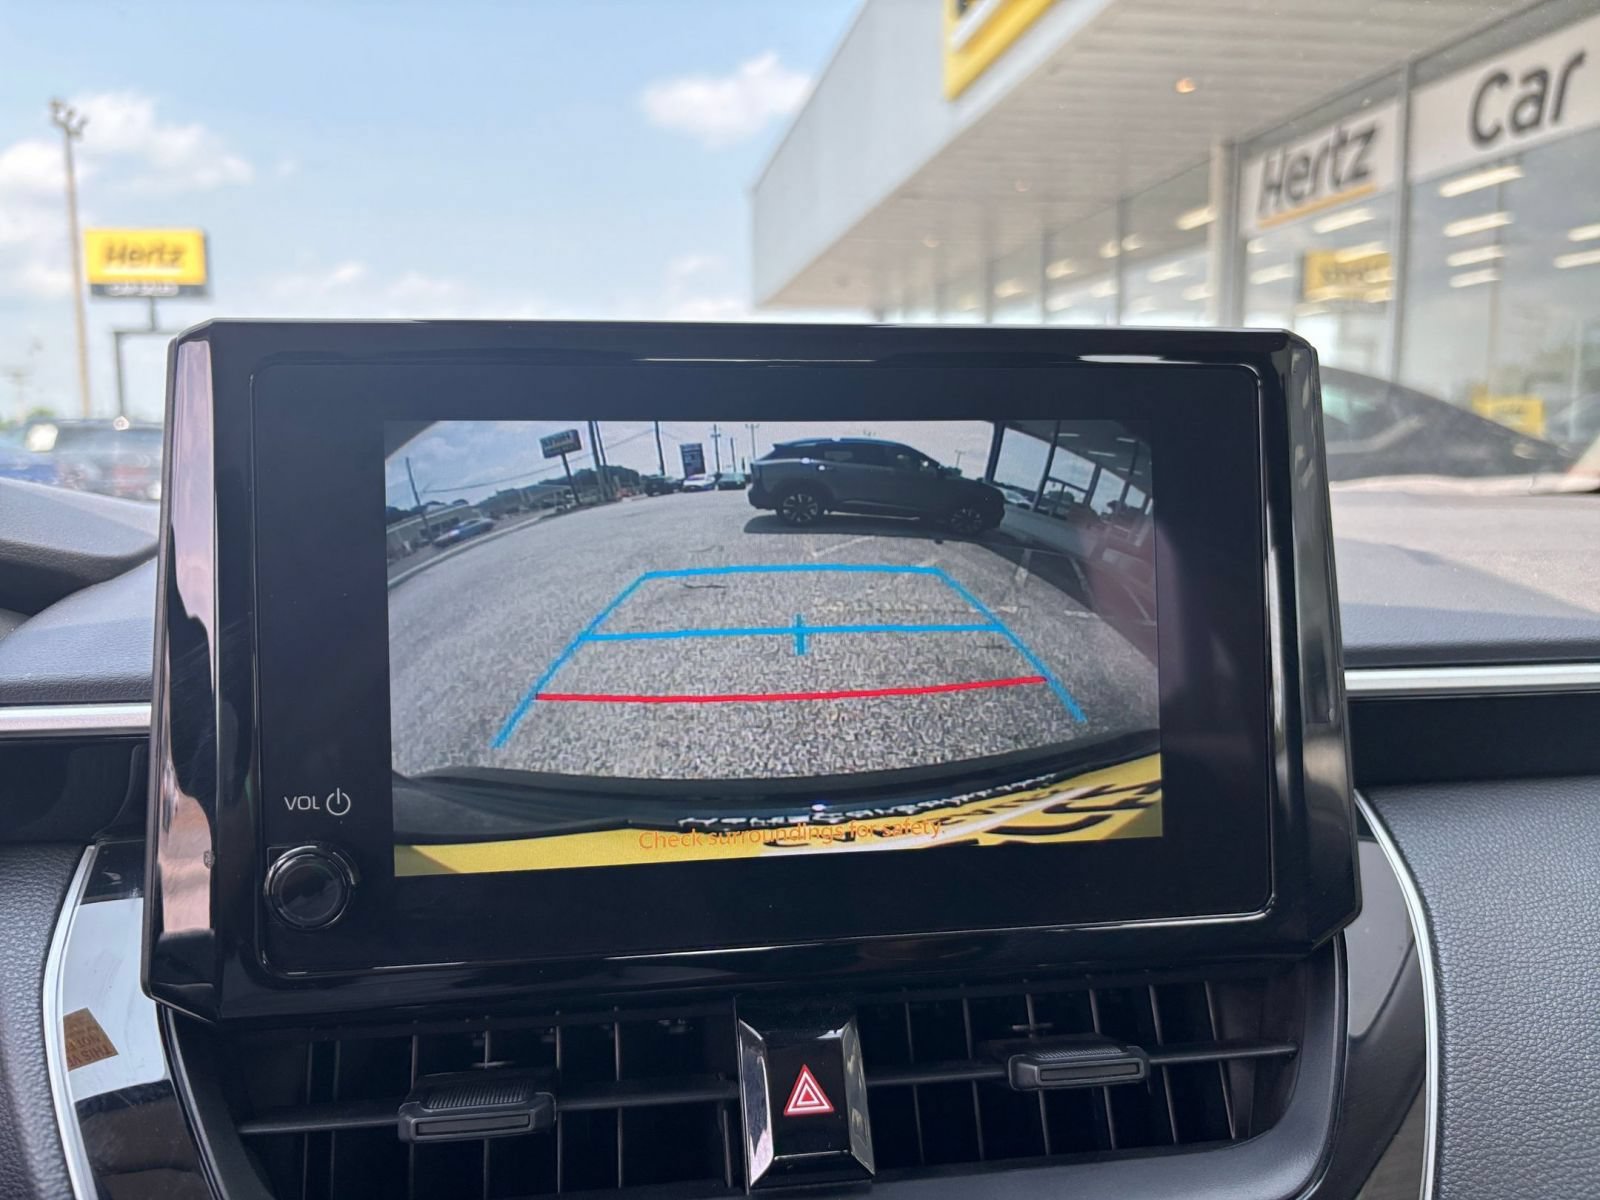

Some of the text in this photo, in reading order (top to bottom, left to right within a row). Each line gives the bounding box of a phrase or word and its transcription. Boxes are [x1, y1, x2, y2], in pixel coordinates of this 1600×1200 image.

[1258, 50, 1586, 214] Hertz Car
[104, 241, 185, 267] Hertz
[284, 796, 321, 811] VOL
[639, 828, 704, 849] Check
[708, 821, 844, 846] surroundings
[849, 819, 878, 838] for
